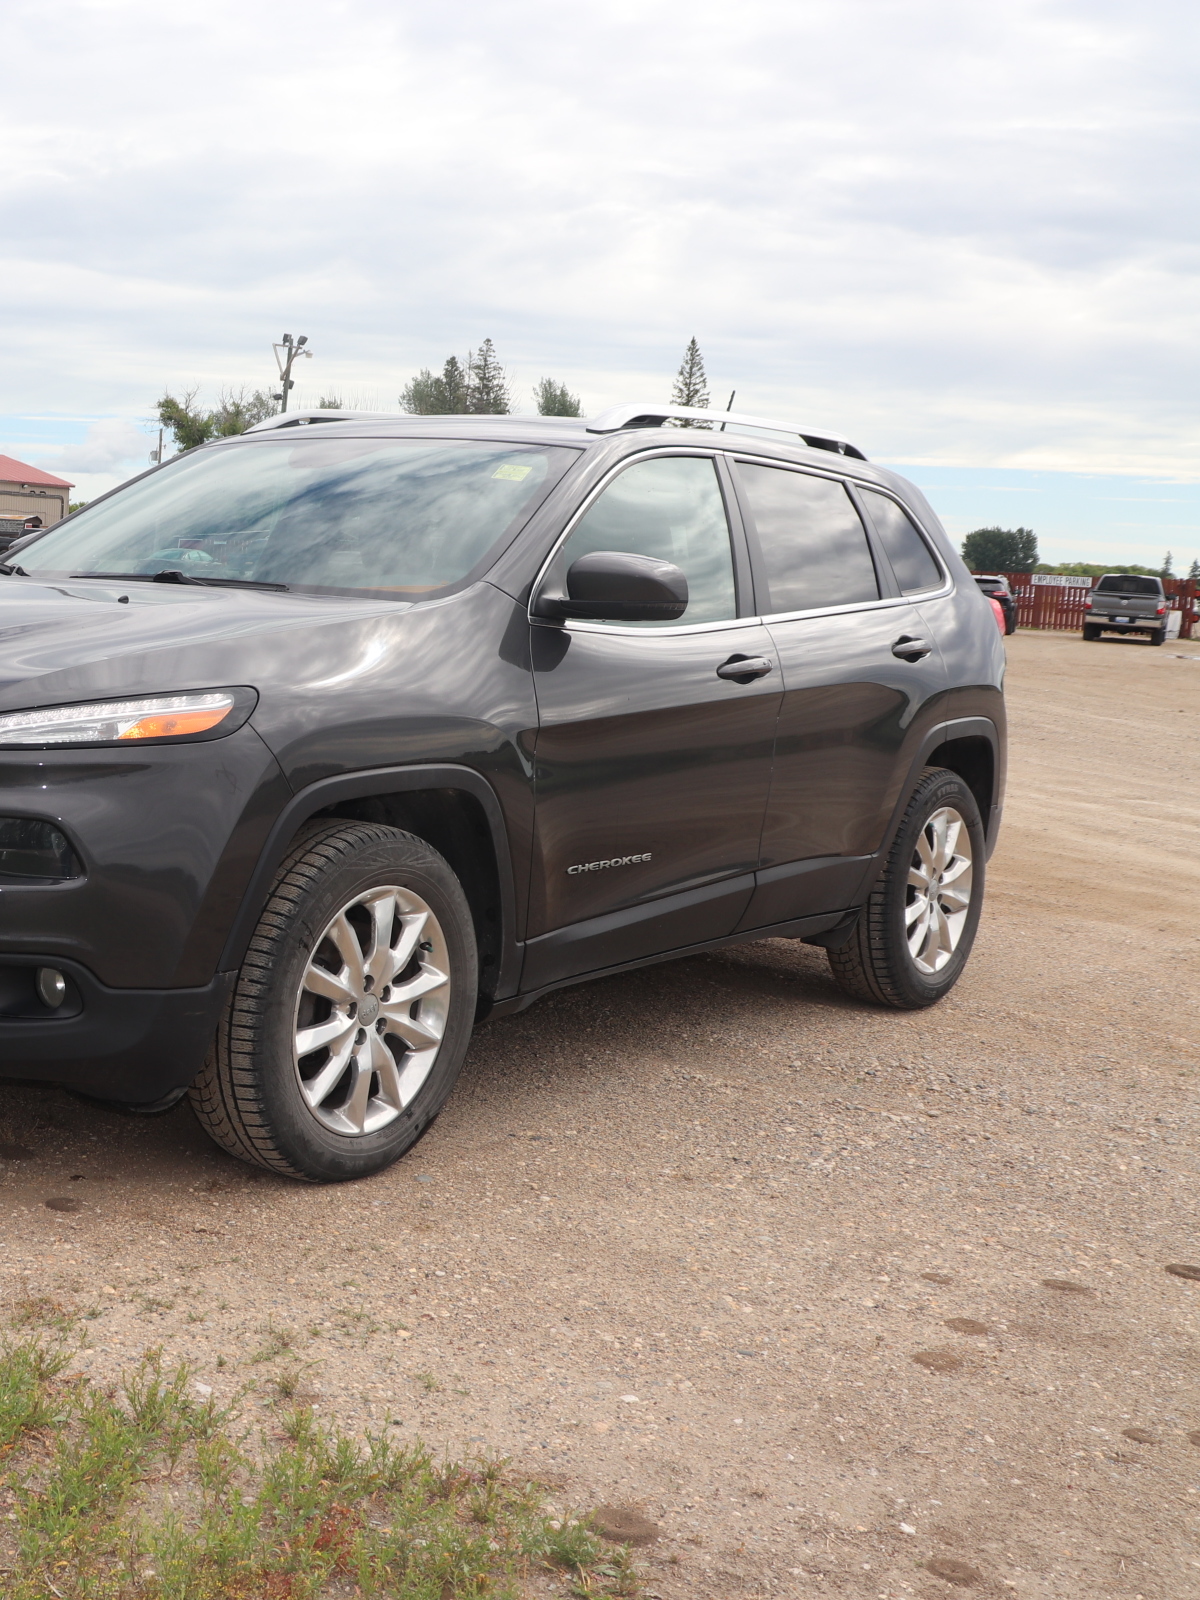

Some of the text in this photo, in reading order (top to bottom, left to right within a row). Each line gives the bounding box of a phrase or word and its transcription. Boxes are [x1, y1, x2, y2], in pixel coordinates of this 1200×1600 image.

[1033, 574, 1091, 587] EMPLOYEE PARKING
[566, 852, 652, 875] CHEROKEE
